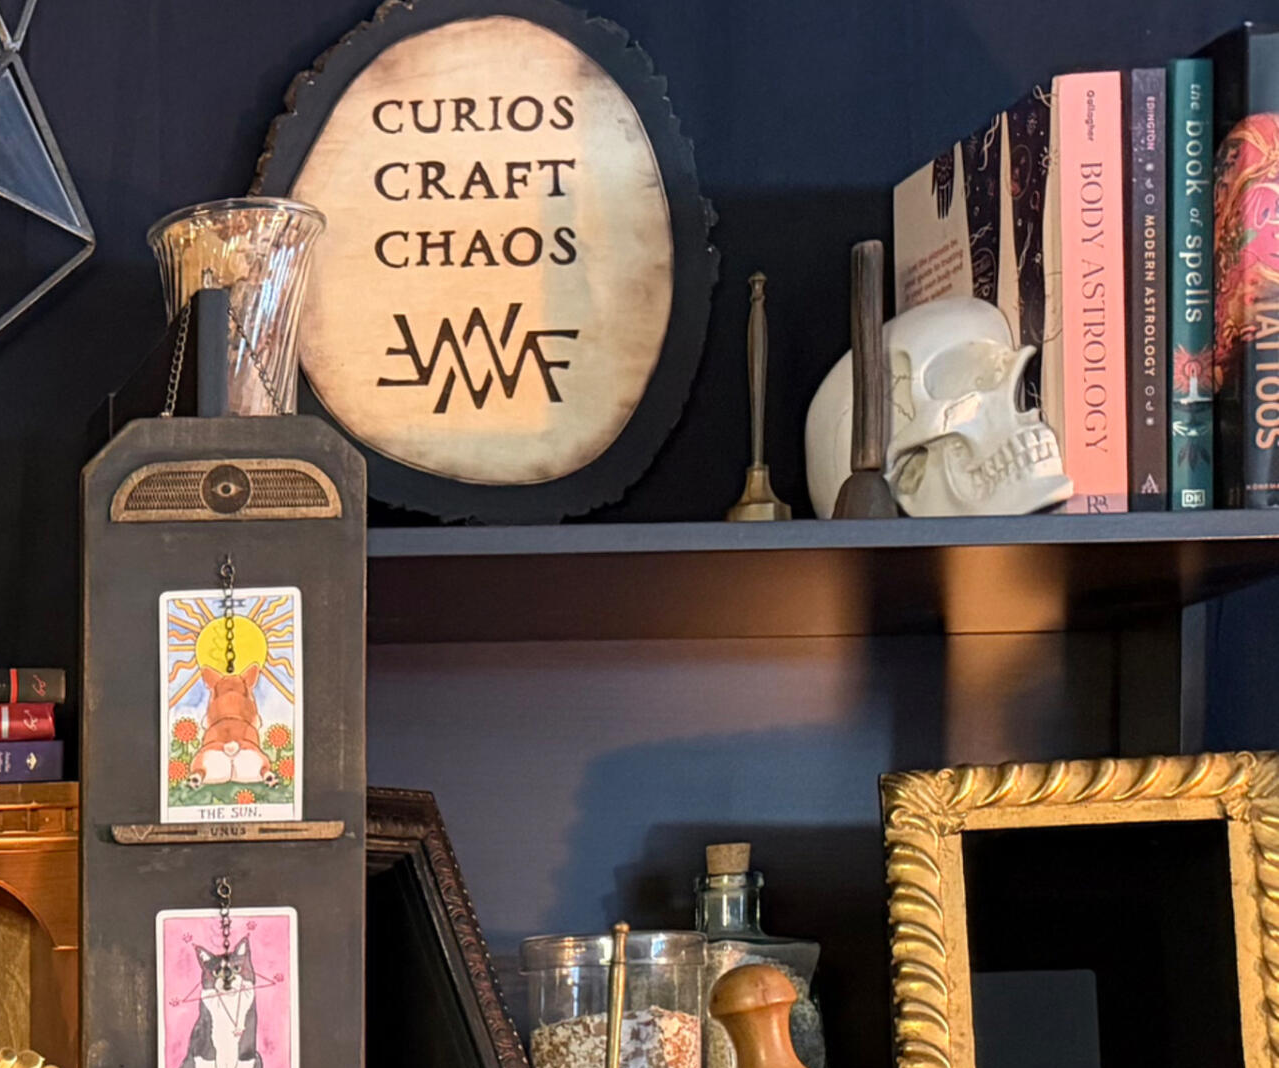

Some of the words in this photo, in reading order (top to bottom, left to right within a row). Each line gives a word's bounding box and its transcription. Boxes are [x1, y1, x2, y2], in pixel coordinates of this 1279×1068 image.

[373, 96, 574, 134] CURIOS
[1146, 96, 1156, 151] EDINGTON
[1190, 84, 1201, 110] the
[374, 159, 576, 200] CRAFT
[1185, 121, 1210, 195] book
[1080, 162, 1105, 248] BODY
[1190, 208, 1203, 227] of
[375, 227, 577, 268] CHAOS
[1144, 215, 1156, 281] MODERN
[1179, 235, 1210, 322] spells
[1081, 259, 1108, 453] ASTROLOGY
[1144, 288, 1155, 376] ASTROLOGY
[199, 807, 225, 819] THE
